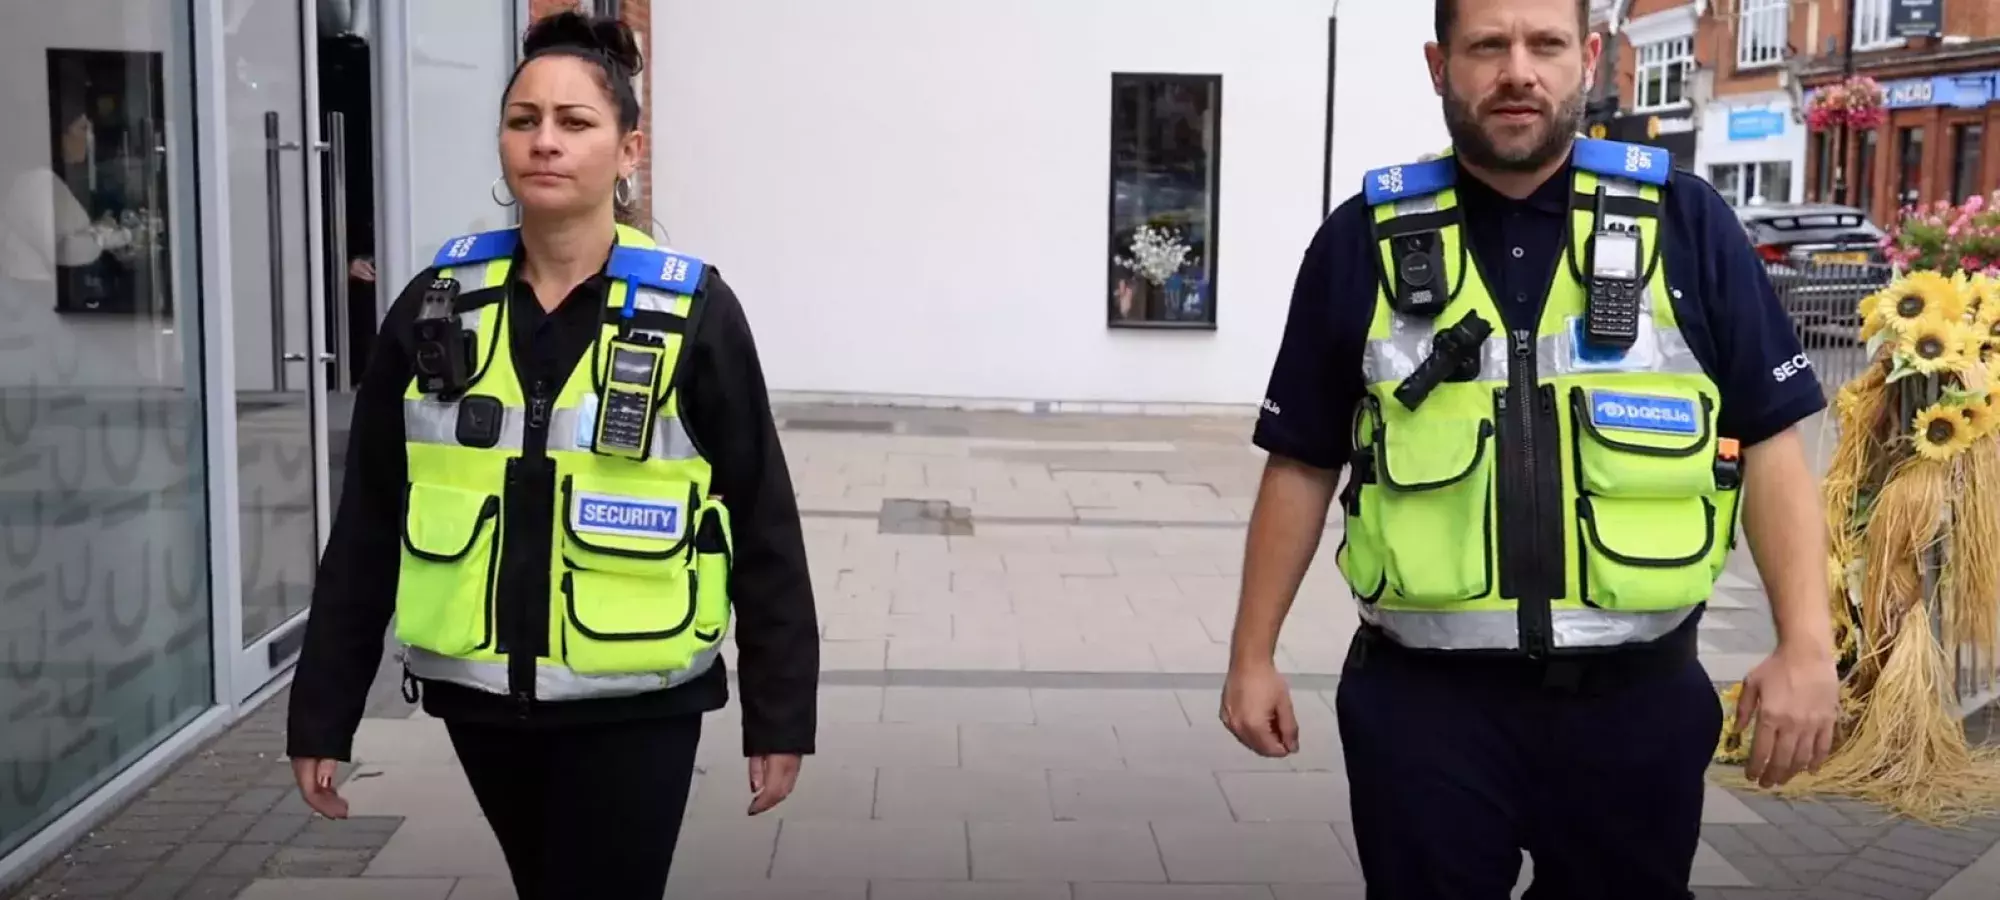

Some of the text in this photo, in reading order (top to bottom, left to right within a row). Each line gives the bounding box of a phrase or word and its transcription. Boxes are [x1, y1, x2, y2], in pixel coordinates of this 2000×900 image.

[1625, 145, 1640, 172] DGCS
[1389, 166, 1404, 194] DGCS
[584, 503, 672, 527] SECURITY
